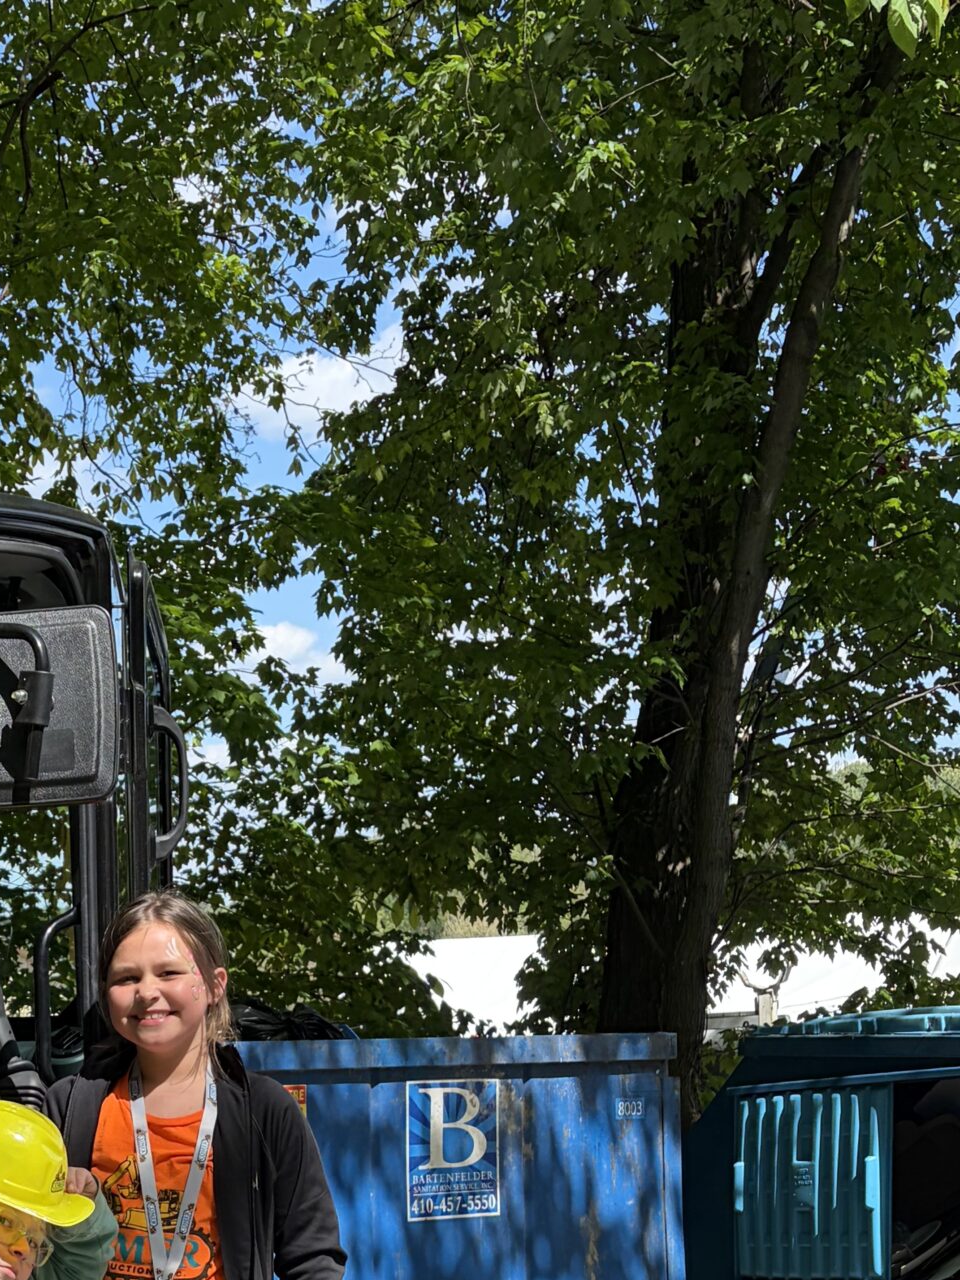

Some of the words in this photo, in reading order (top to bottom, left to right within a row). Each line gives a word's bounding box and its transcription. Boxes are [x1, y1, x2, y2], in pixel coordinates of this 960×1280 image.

[618, 1101, 642, 1116] 8003
[418, 1087, 488, 1170] B
[412, 1171, 494, 1184] BARTENFELDER
[411, 1194, 497, 1215] 410-457-5550
